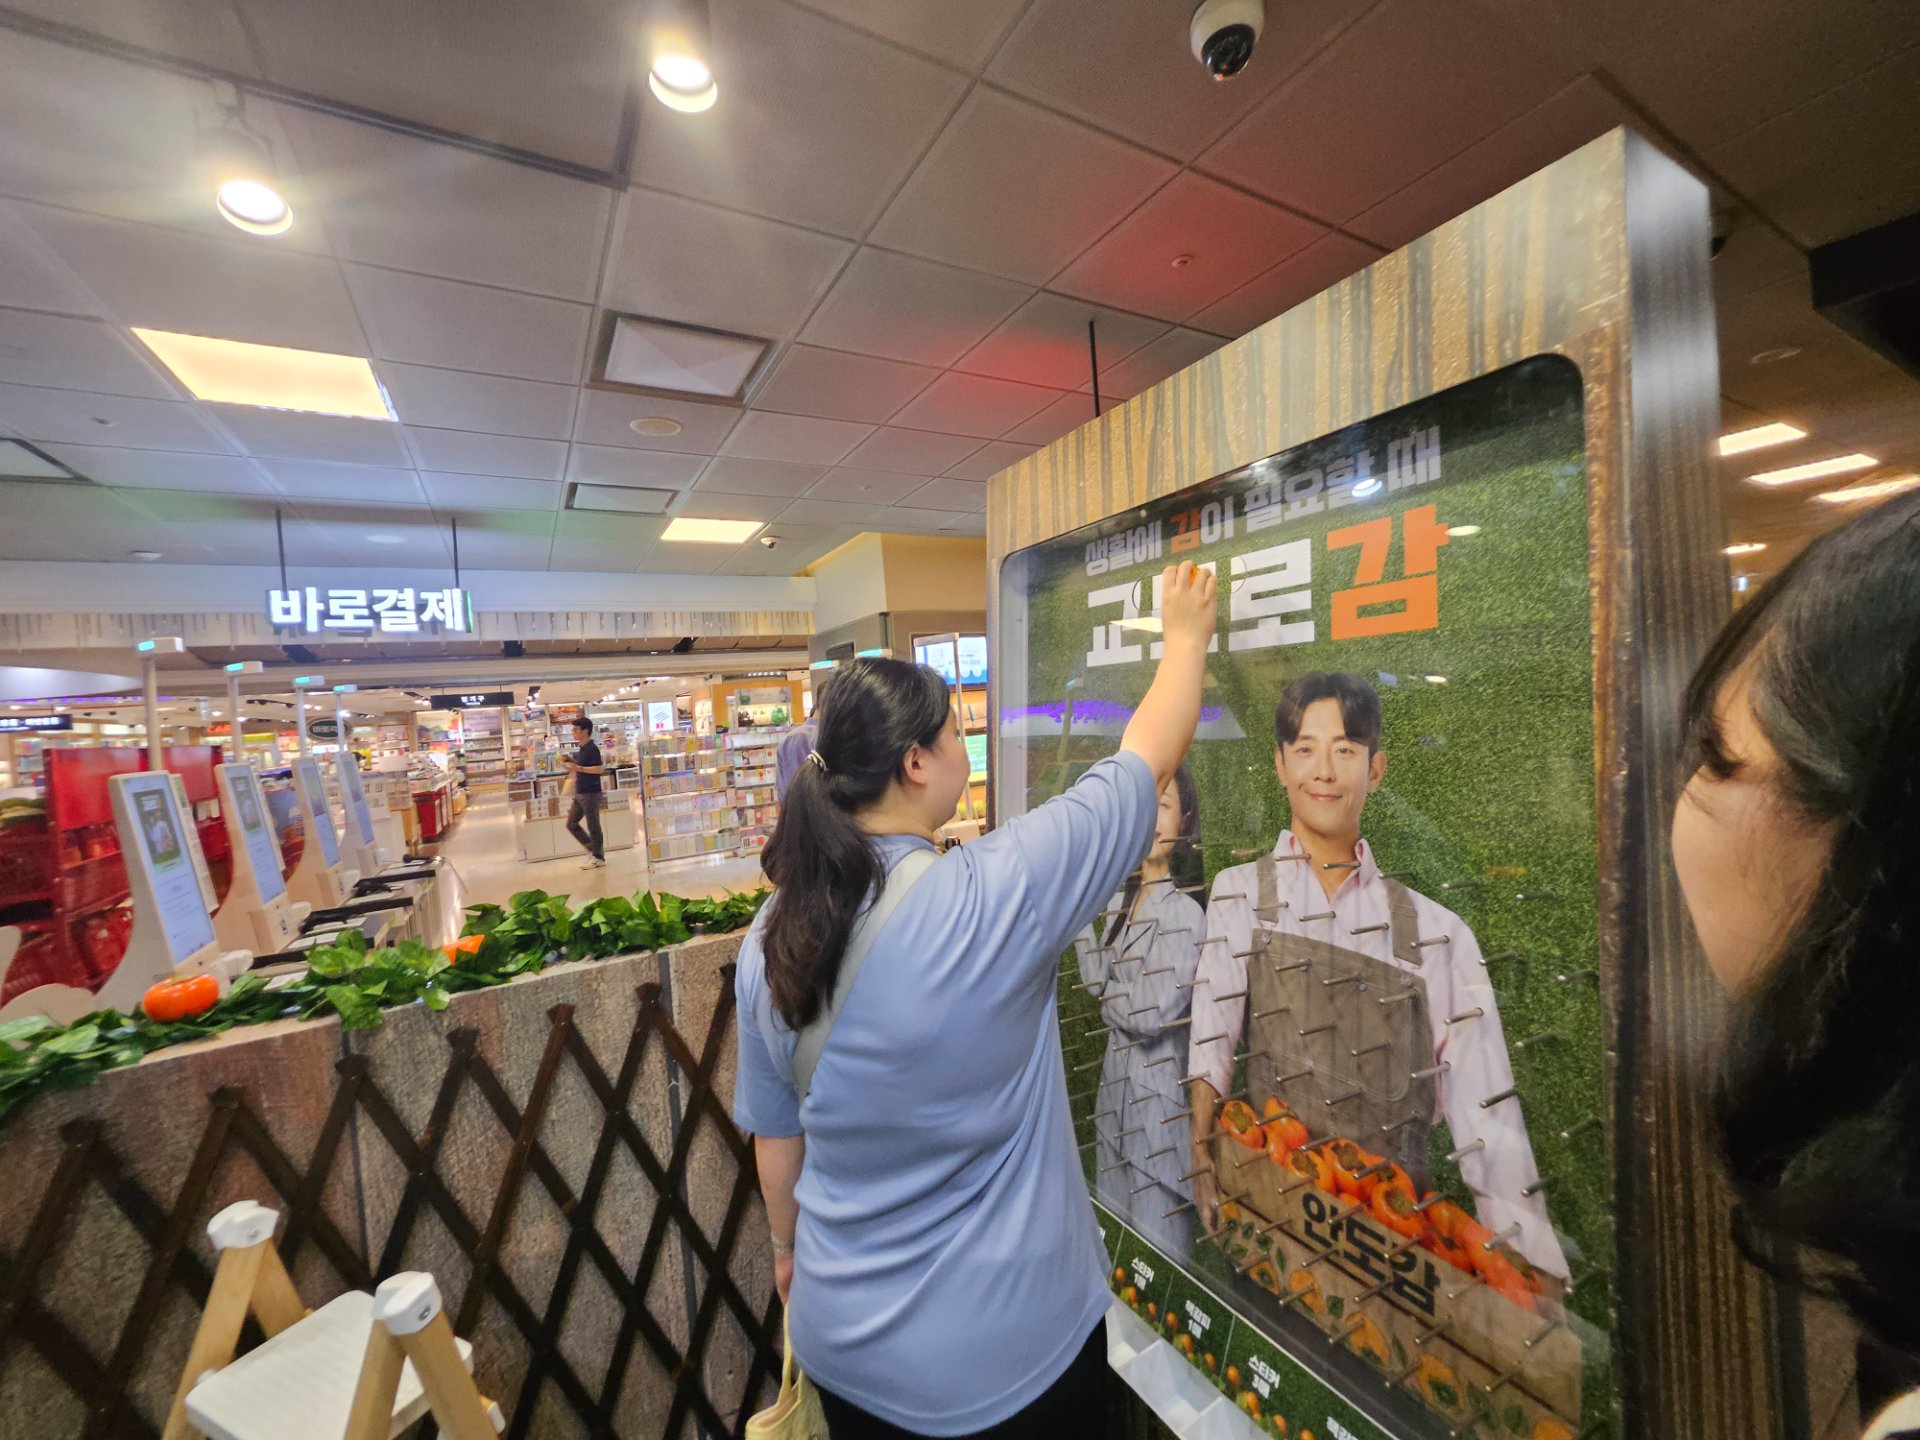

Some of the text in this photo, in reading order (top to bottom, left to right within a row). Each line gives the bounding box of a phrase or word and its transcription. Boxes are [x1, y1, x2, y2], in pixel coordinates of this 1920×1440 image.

[1085, 426, 1441, 577] 생활에 감이 필요할 때
[269, 586, 464, 633] 바로결제
[1131, 1257, 1155, 1283] 스티커
[1302, 1193, 1440, 1316] 안도감
[1248, 1354, 1281, 1390] 스티커
